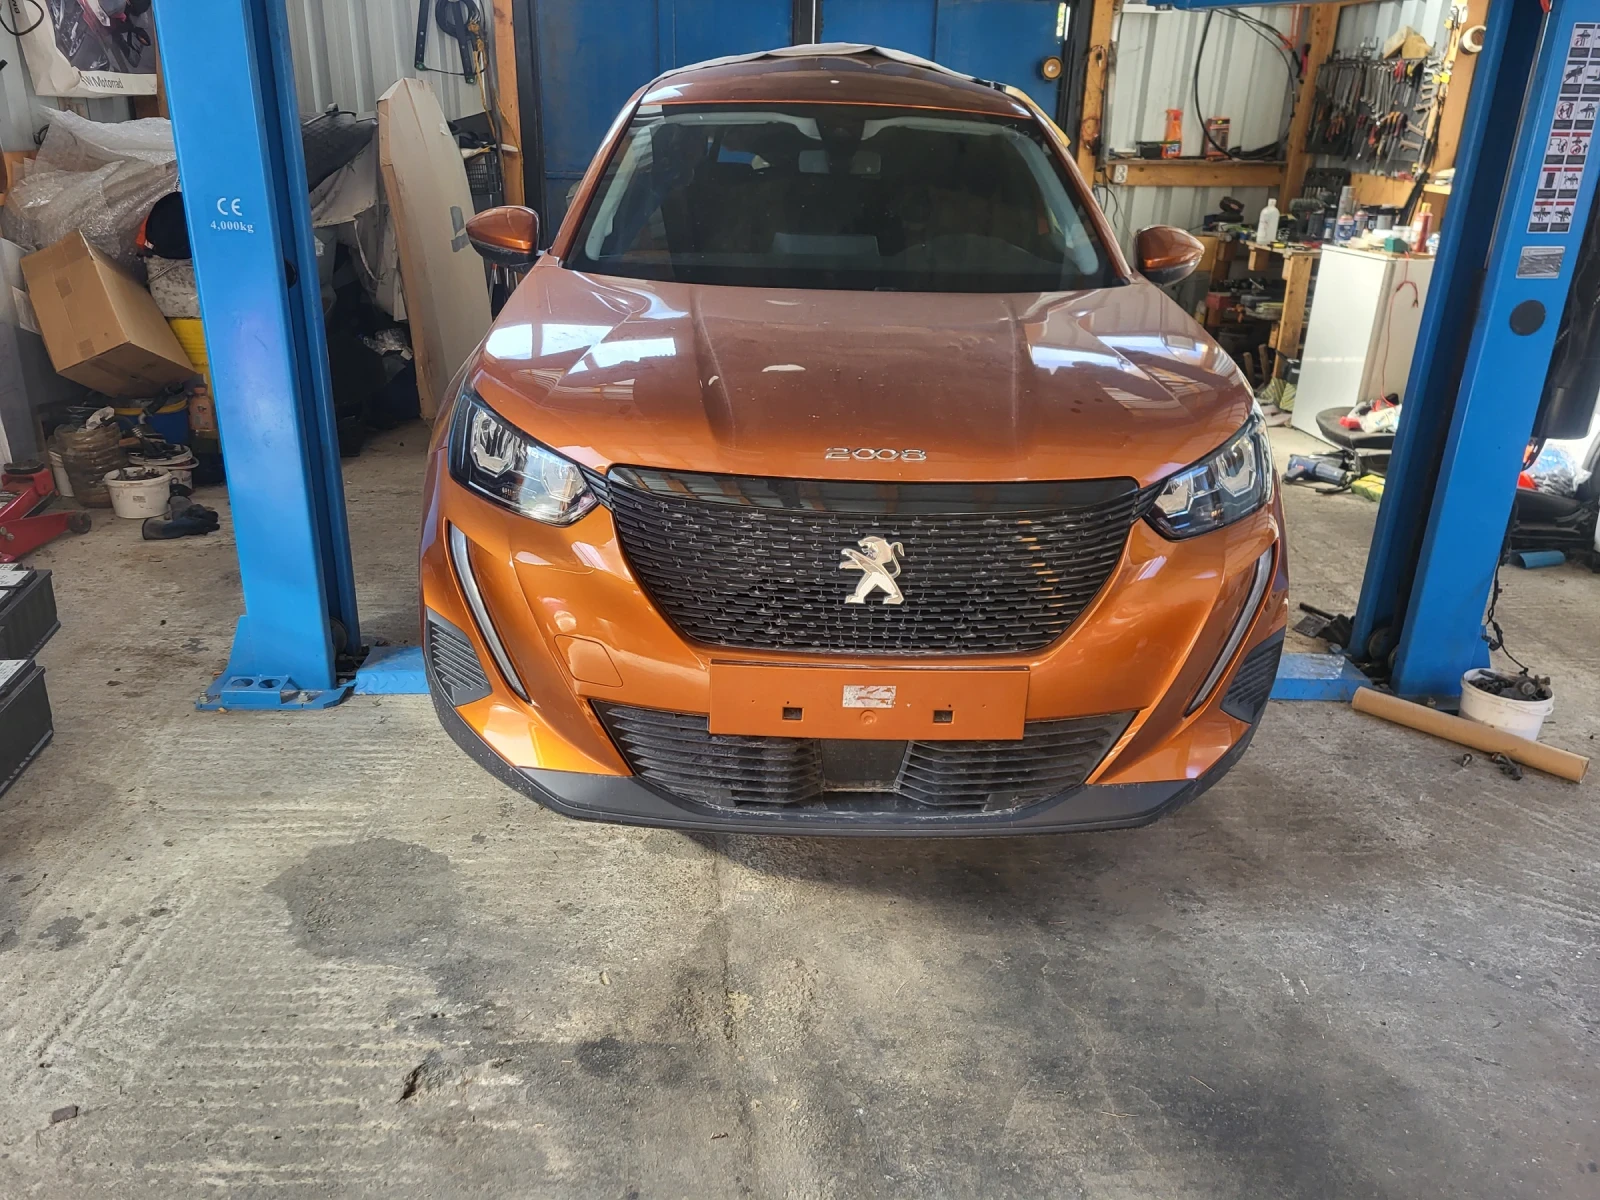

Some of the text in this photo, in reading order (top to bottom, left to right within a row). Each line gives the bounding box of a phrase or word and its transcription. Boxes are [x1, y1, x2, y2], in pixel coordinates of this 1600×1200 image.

[91, 75, 124, 89] Motorrad
[216, 197, 243, 216] CE
[210, 220, 254, 234] 4,000kg
[824, 447, 927, 463] 2008
